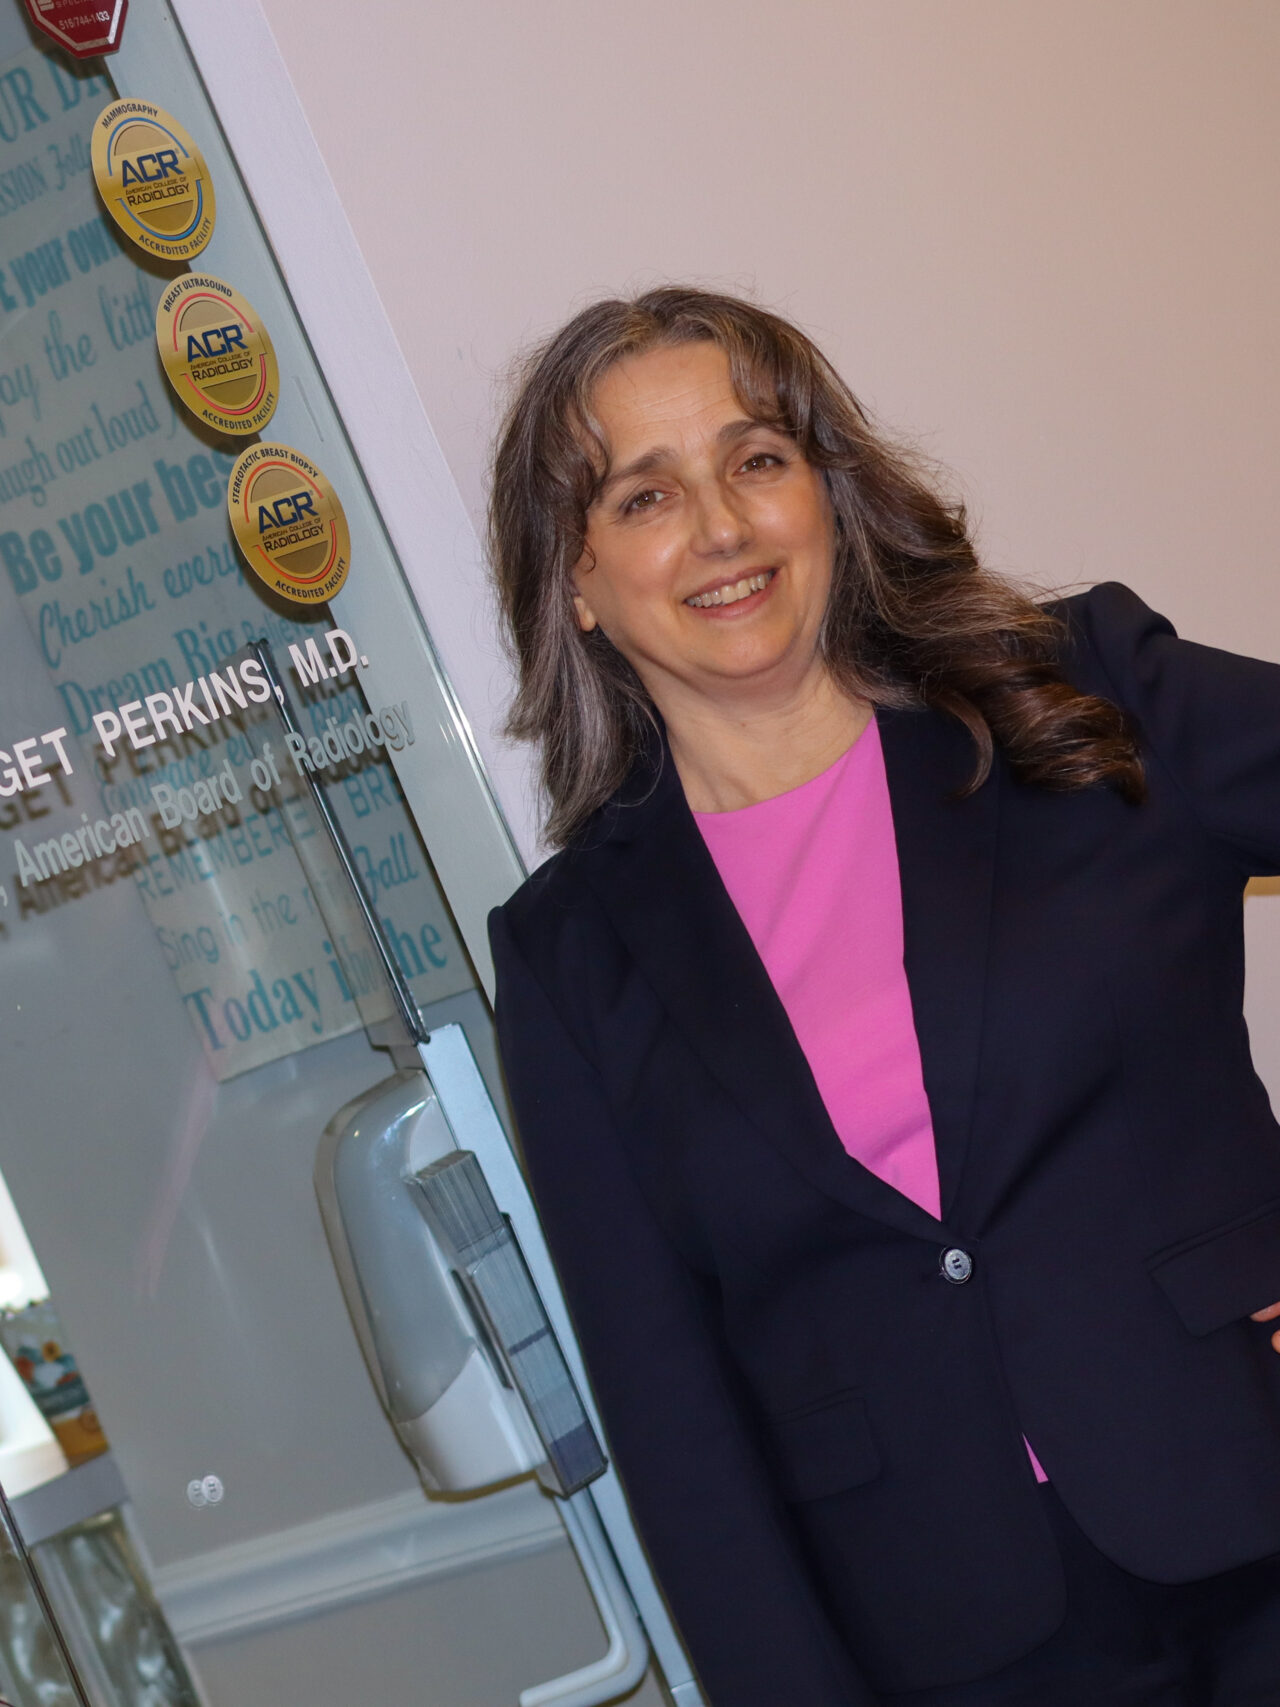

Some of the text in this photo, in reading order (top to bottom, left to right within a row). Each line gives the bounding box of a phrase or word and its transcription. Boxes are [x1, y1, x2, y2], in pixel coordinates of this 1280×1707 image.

[102, 103, 158, 128] MAMMOGRAPHY
[122, 149, 184, 187] ACR
[126, 183, 190, 207] RADIOLOGY
[139, 217, 212, 256] ACCREDITED FACILITY
[9, 237, 71, 308] your
[163, 278, 233, 313] BREAST ULTRASOUND
[44, 309, 98, 381] the
[98, 266, 157, 352] littl
[187, 324, 248, 363] ACR
[191, 357, 254, 381] RADIOLOGY
[56, 424, 102, 474] out
[91, 377, 160, 454] loud
[202, 409, 252, 430] ACCREDITED
[253, 392, 275, 425] FACILITY
[232, 448, 318, 504] STEREOTACTIC BREAST BIOPSY
[57, 478, 160, 576] your
[154, 450, 236, 523] bes
[258, 491, 318, 534] ACR
[263, 524, 325, 552] RADIOLOGY
[275, 557, 347, 598] ACCREDITED FACILITY
[39, 566, 156, 669] Cherish
[57, 657, 173, 737] Dream
[174, 621, 238, 680] Big
[92, 658, 285, 758] PERKINS,
[288, 628, 369, 687] M.D.
[14, 806, 150, 888] American
[151, 759, 243, 830] Board
[250, 742, 281, 792] of
[284, 698, 417, 776] Radiology
[182, 967, 325, 1051] Today
